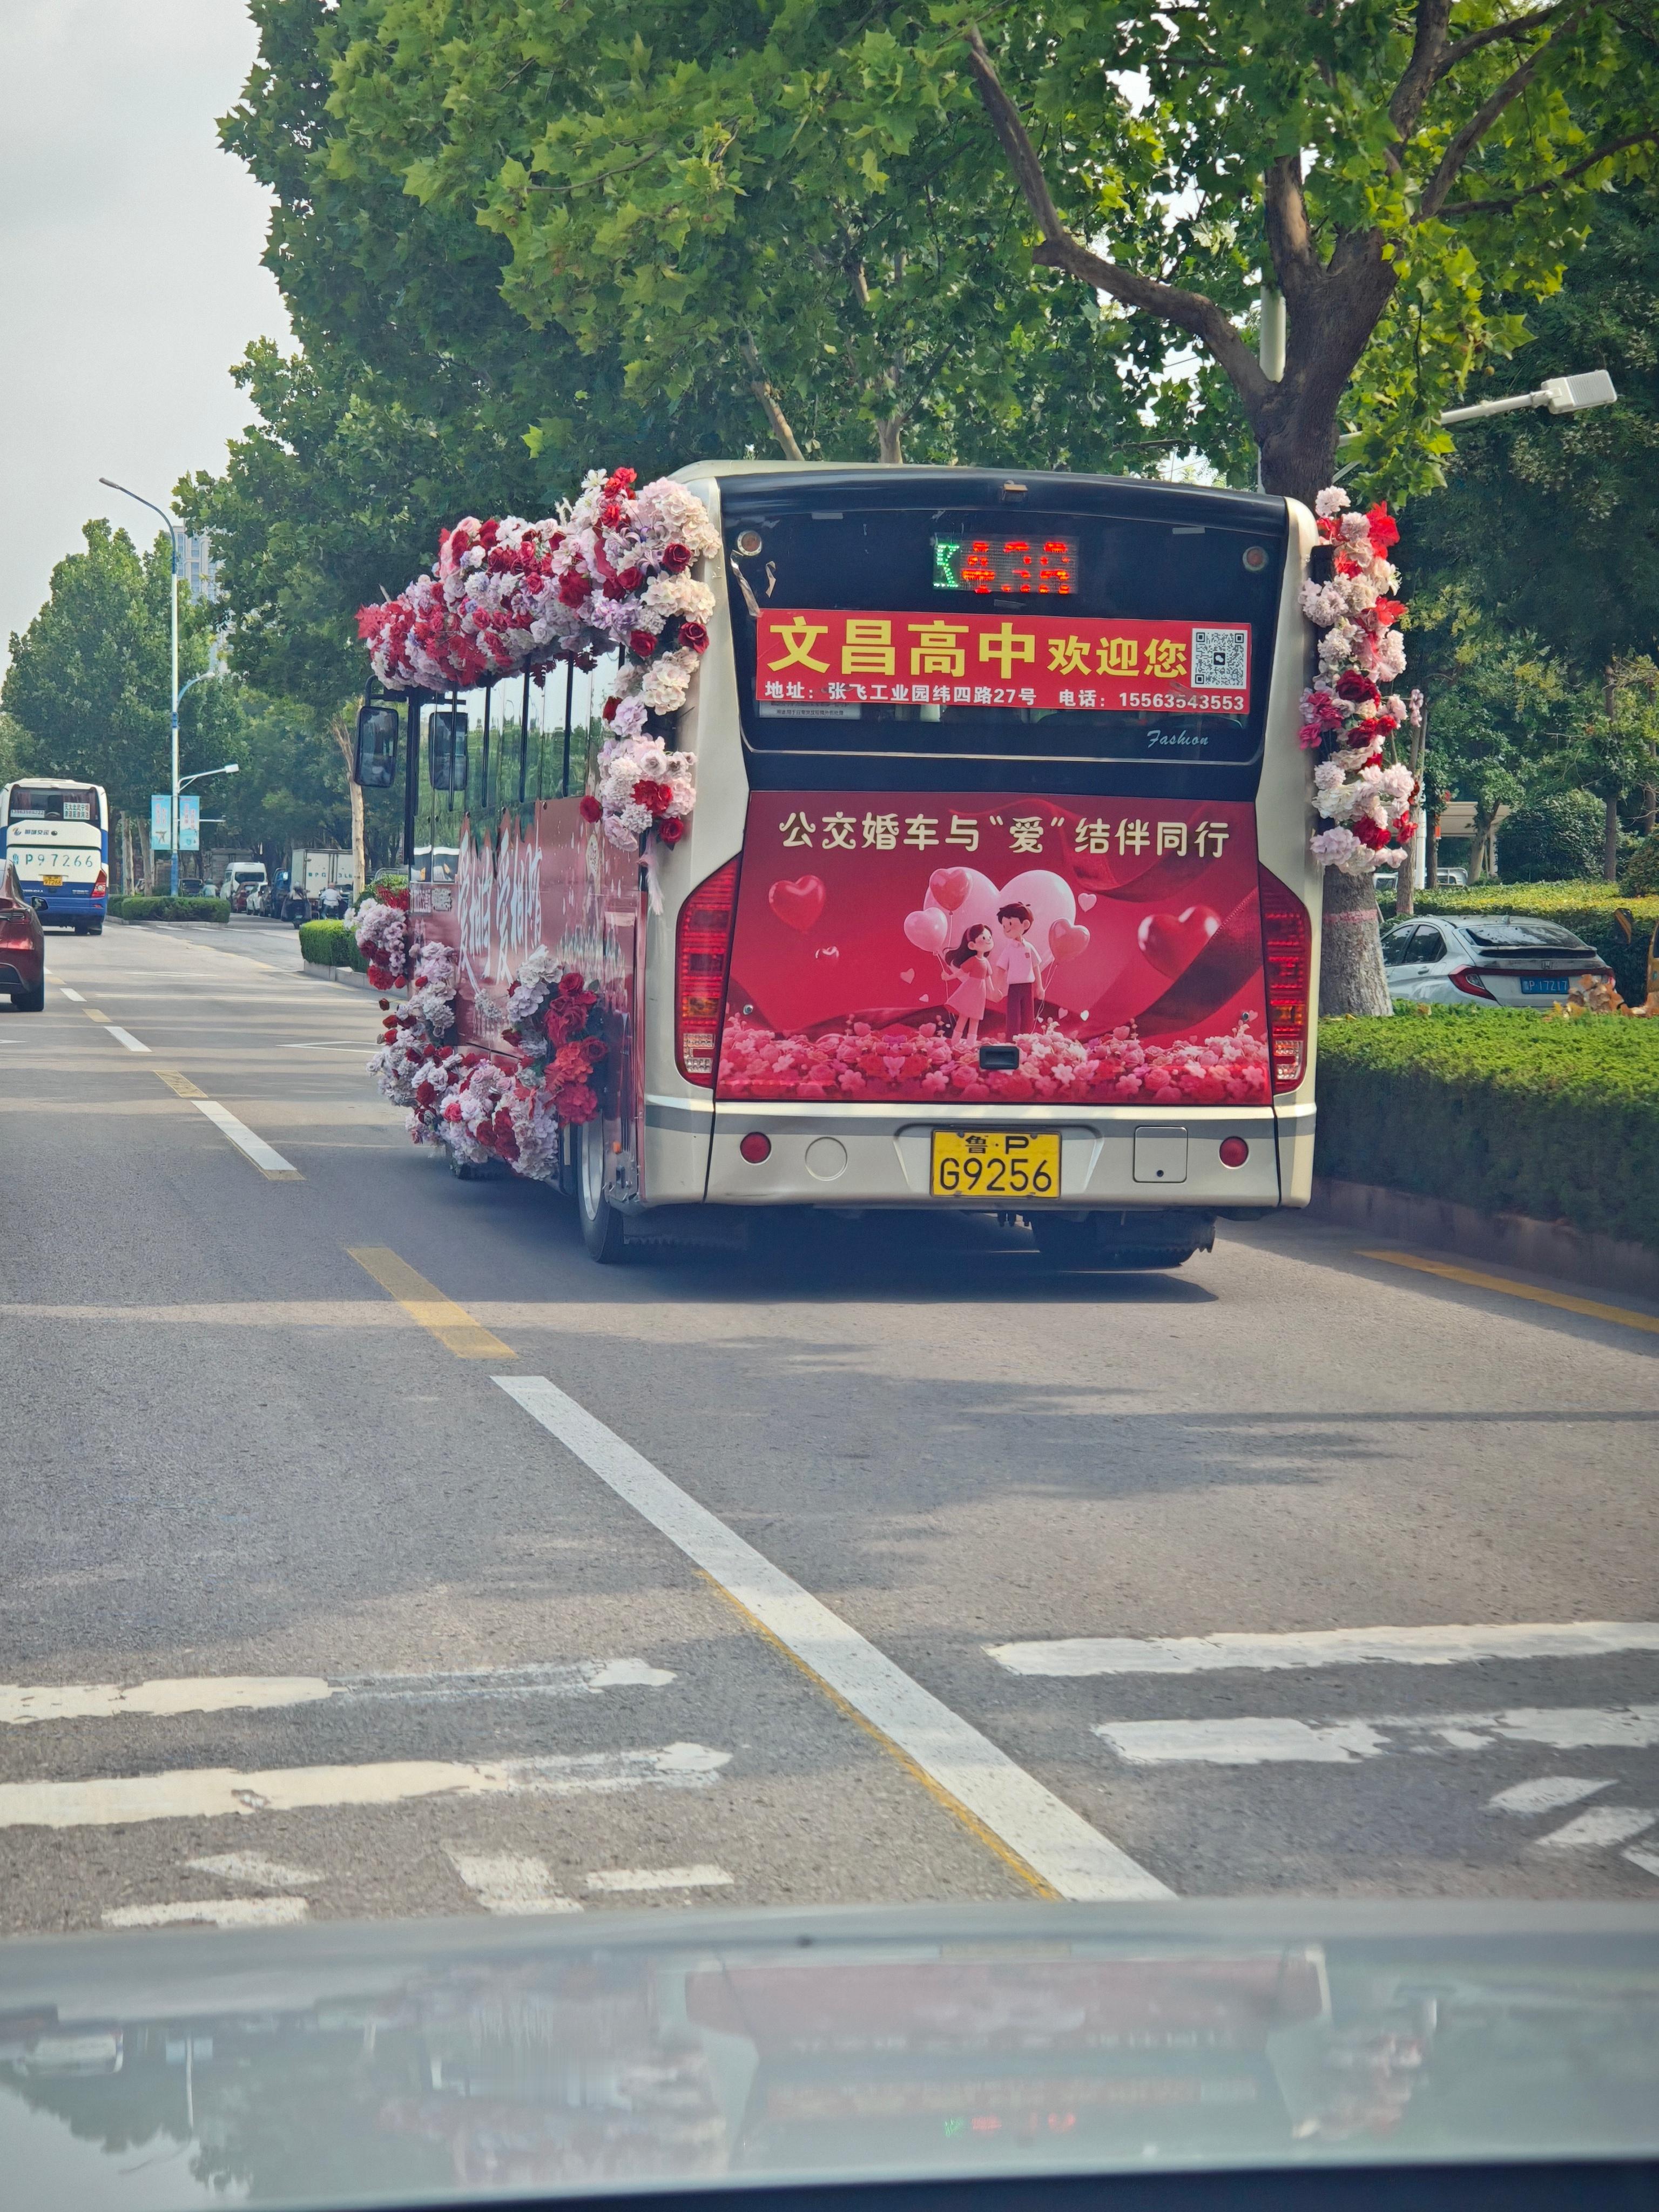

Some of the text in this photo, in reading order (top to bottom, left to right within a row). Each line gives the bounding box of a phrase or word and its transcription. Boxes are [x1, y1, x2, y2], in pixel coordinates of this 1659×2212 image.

[767, 616, 1187, 679] 文昌高中欢迎您
[1147, 730, 1209, 748] Fashion
[965, 1135, 1029, 1155] 鲁·P
[940, 1157, 1052, 1192] G9256
